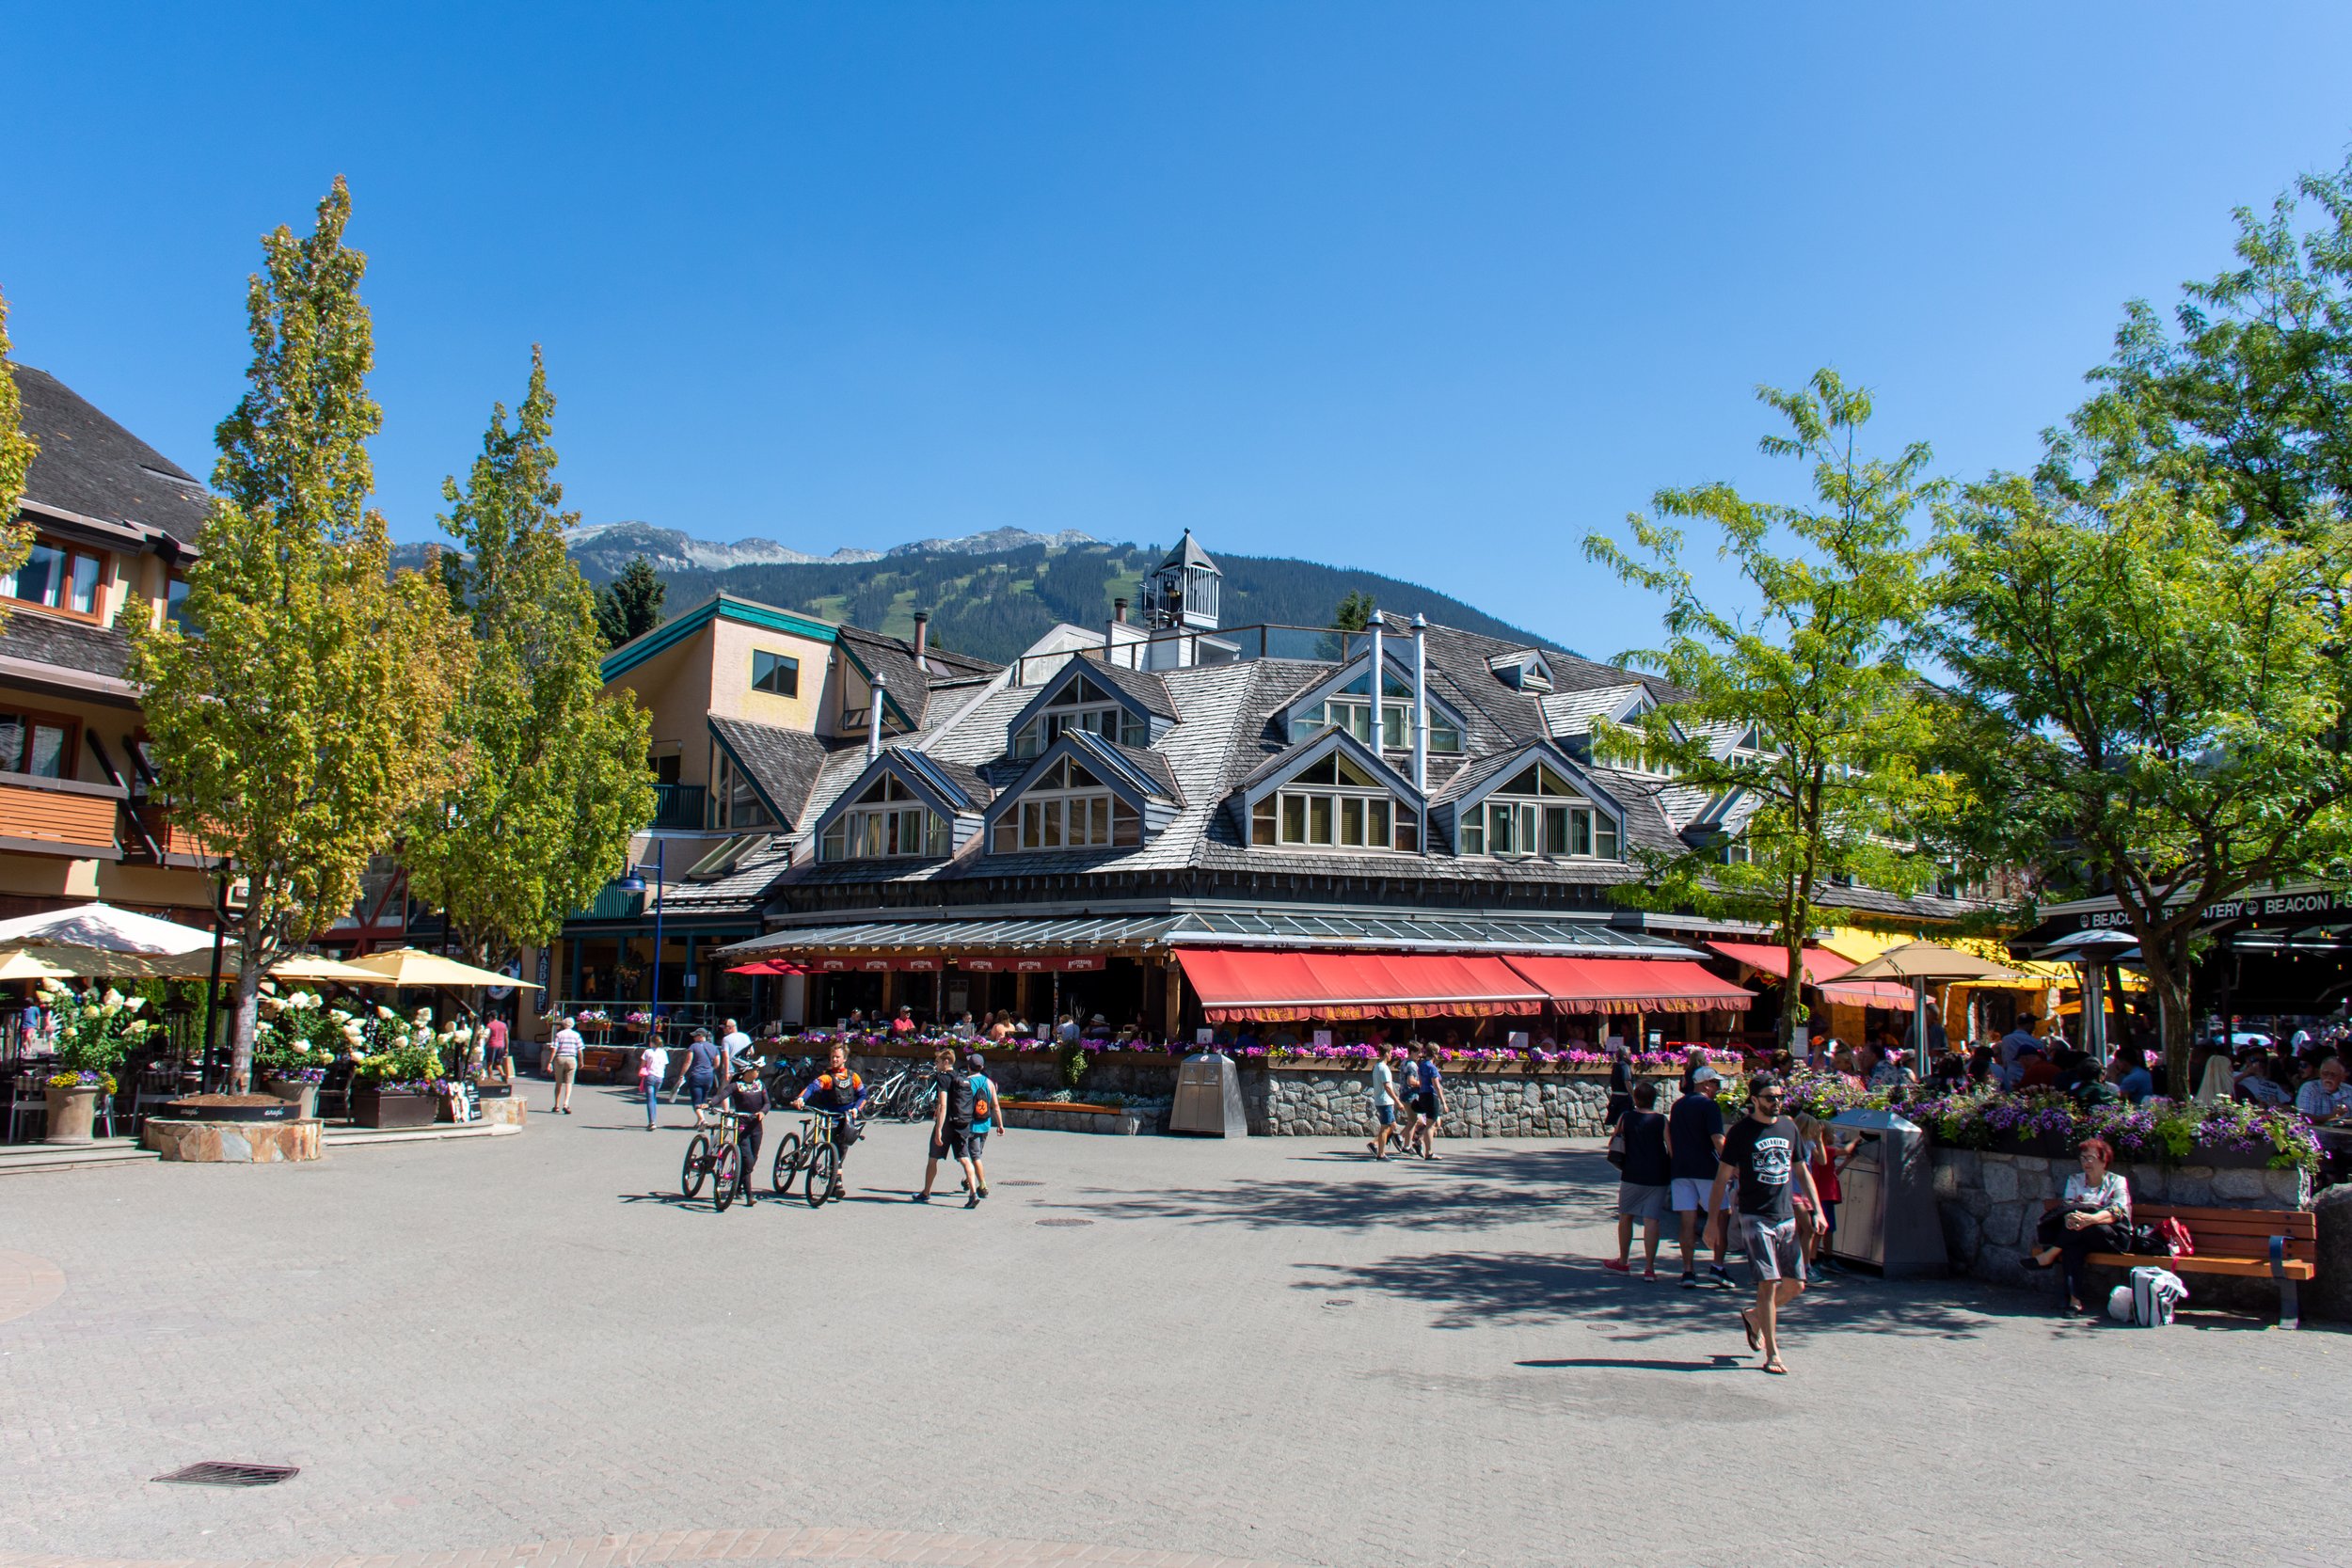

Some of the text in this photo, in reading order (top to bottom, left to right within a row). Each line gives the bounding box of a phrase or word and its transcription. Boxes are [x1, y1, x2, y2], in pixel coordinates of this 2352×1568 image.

[2201, 902, 2244, 919] ATERY
[2265, 894, 2329, 914] BEACON
[2092, 911, 2134, 927] BEACO
